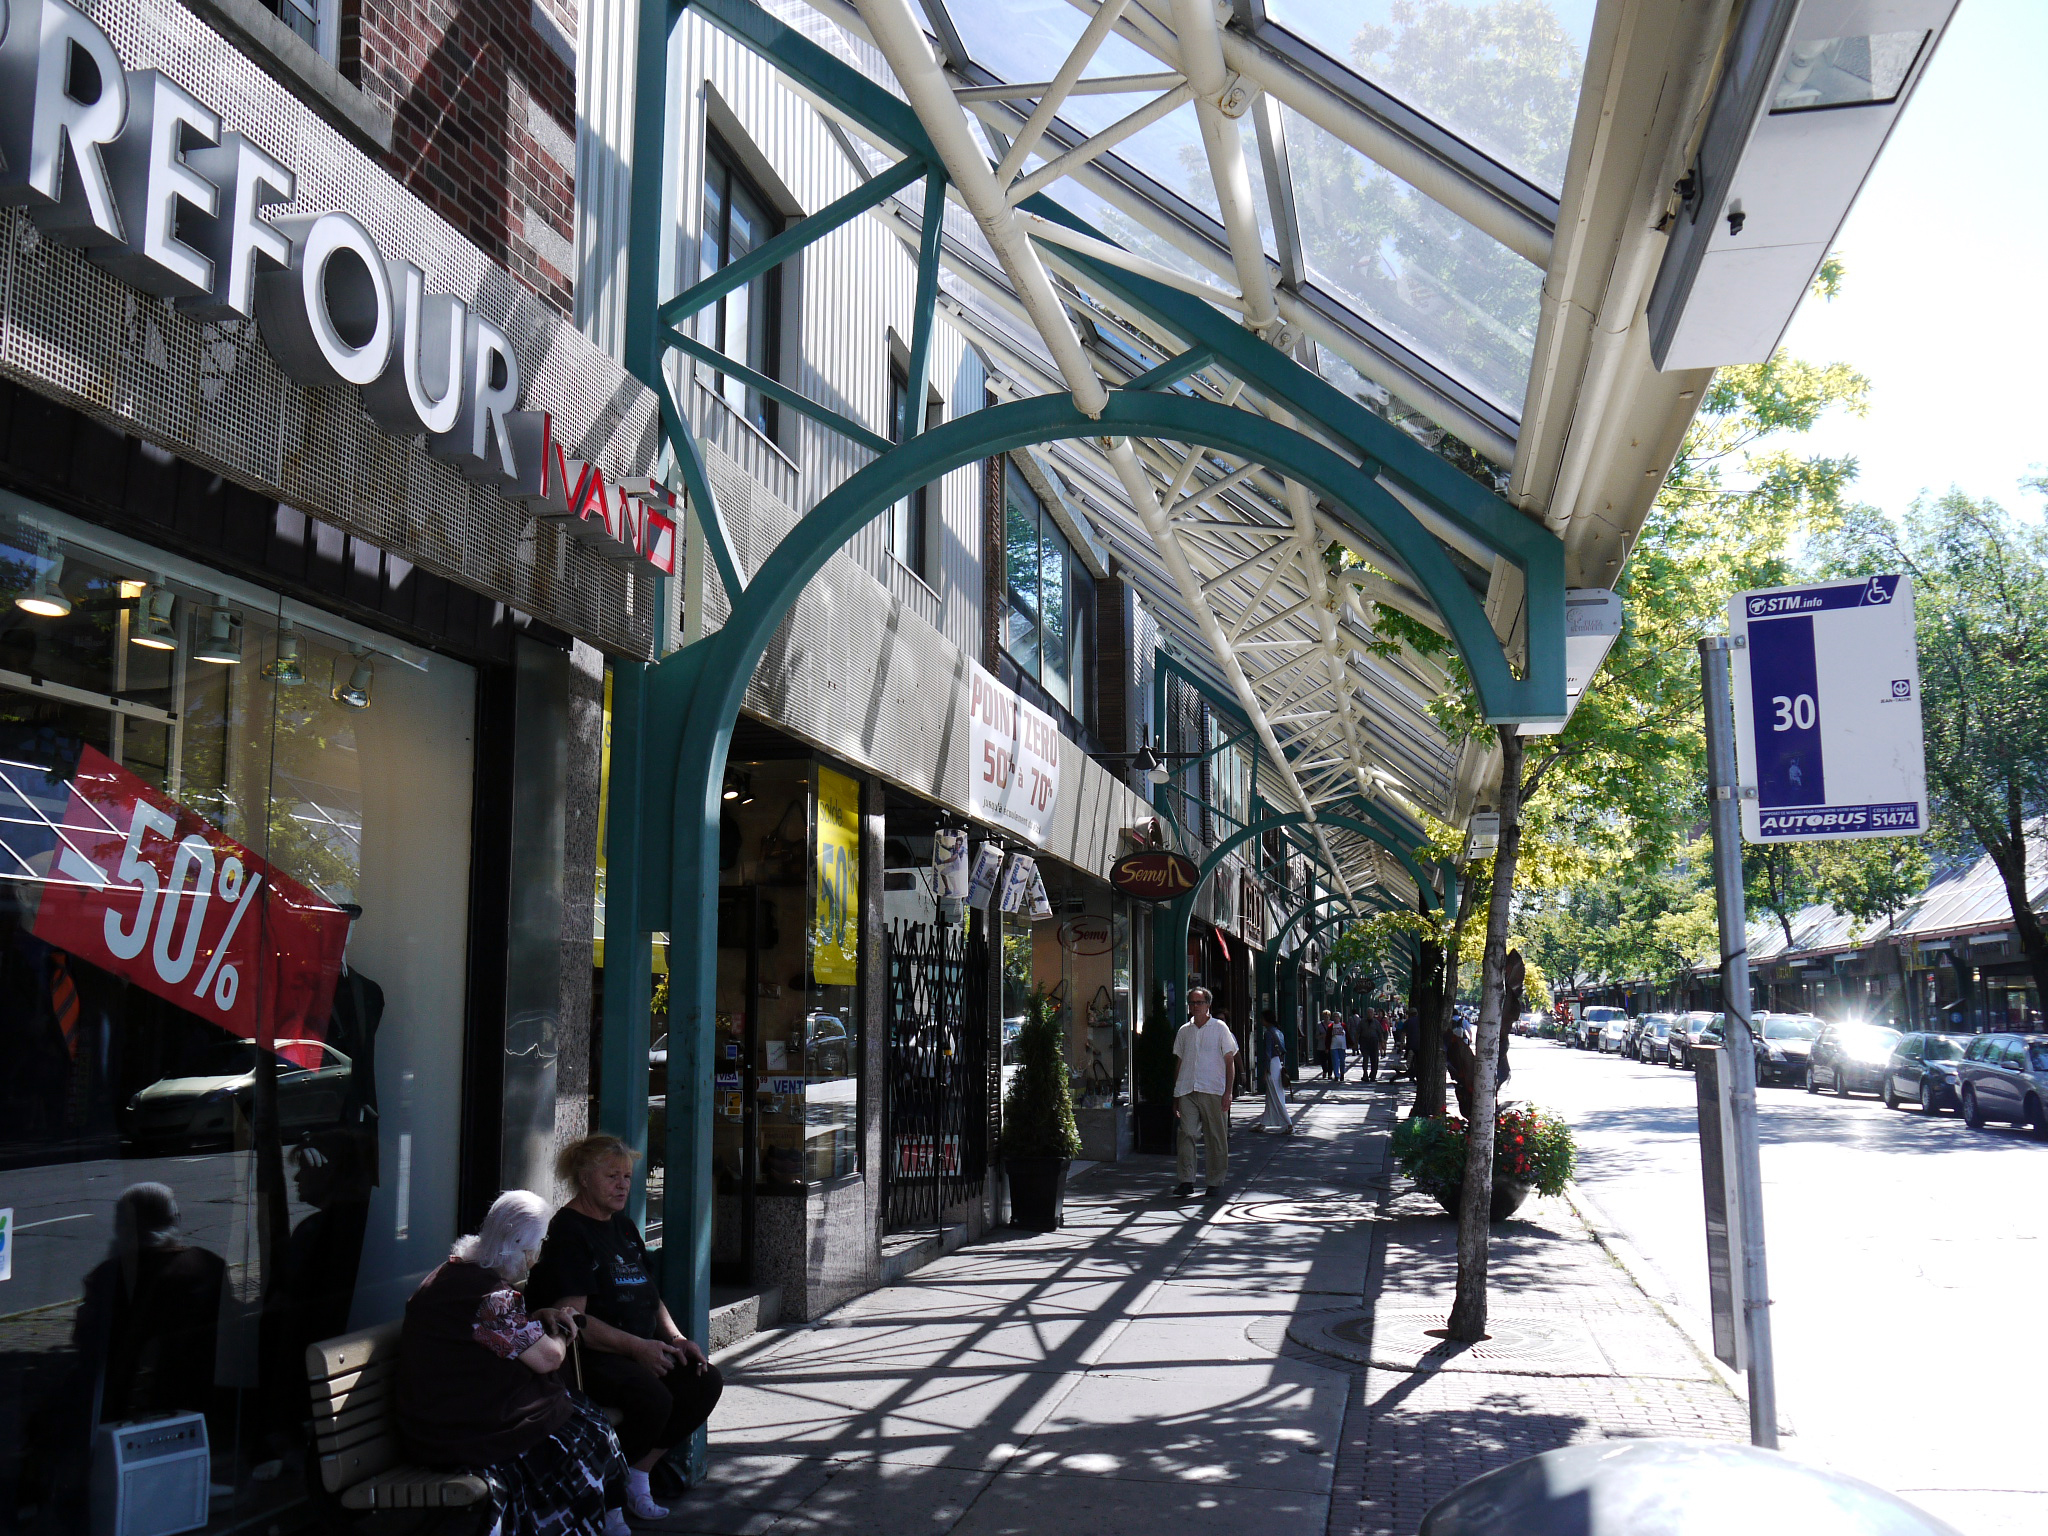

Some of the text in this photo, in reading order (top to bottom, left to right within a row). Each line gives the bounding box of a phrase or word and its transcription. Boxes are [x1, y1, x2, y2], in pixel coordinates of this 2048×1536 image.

[970, 673, 1058, 768] POINT ZERO
[1772, 694, 1816, 731] 30
[983, 738, 1016, 790] 50%
[1030, 766, 1054, 813] 70%
[819, 797, 843, 828] solde
[1761, 812, 1867, 829] AUTOBUS
[1872, 811, 1916, 827] 51474
[1116, 861, 1168, 887] Semy
[58, 798, 262, 1011] -50%
[1002, 886, 1014, 911] POINT
[1069, 923, 1109, 944] Semy
[719, 1072, 738, 1082] VISA
